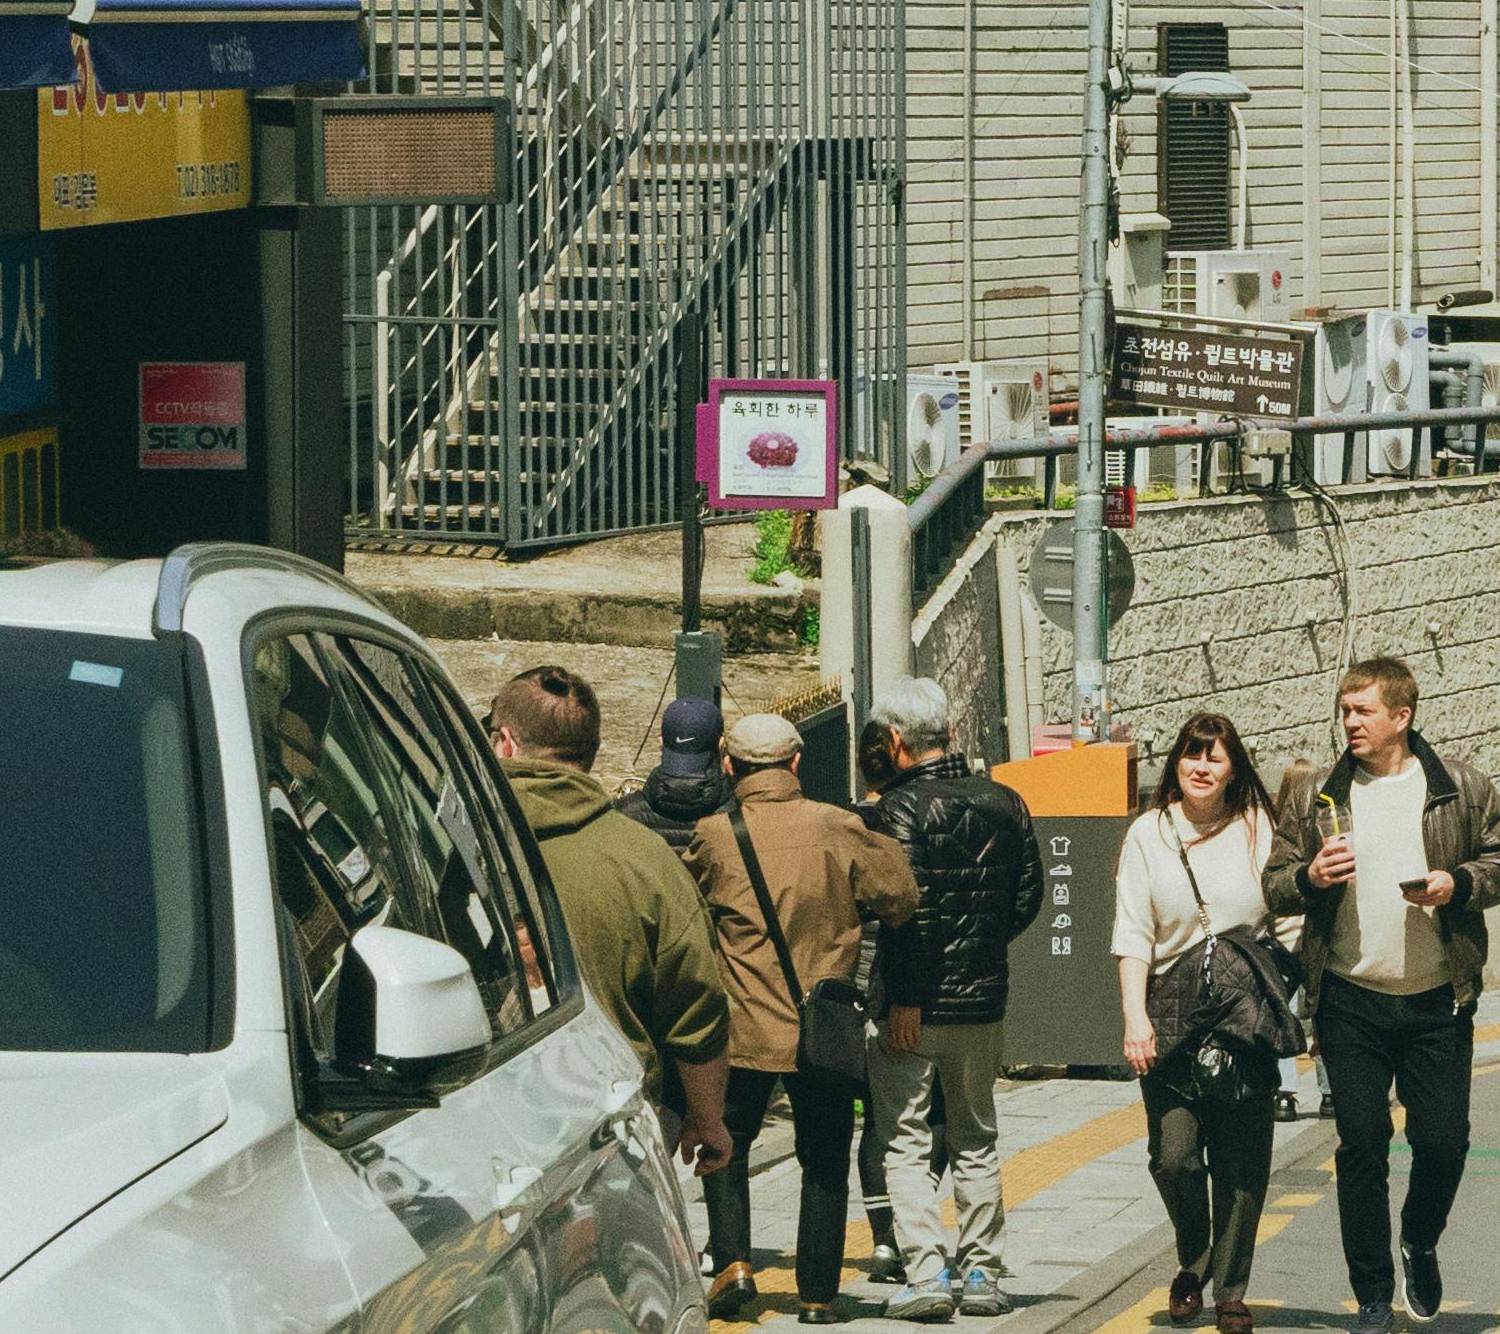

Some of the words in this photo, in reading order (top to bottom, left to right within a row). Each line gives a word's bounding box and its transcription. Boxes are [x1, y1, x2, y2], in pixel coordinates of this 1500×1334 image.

[1120, 361, 1157, 377] Chojun
[1159, 365, 1195, 380] Textile
[1197, 368, 1224, 385] Quilt
[1227, 372, 1245, 386] Art
[1247, 375, 1292, 391] Museum
[731, 400, 781, 419] 육회한
[786, 401, 819, 419] 하루
[1268, 401, 1292, 416] 50M
[147, 426, 238, 450] SECOM
